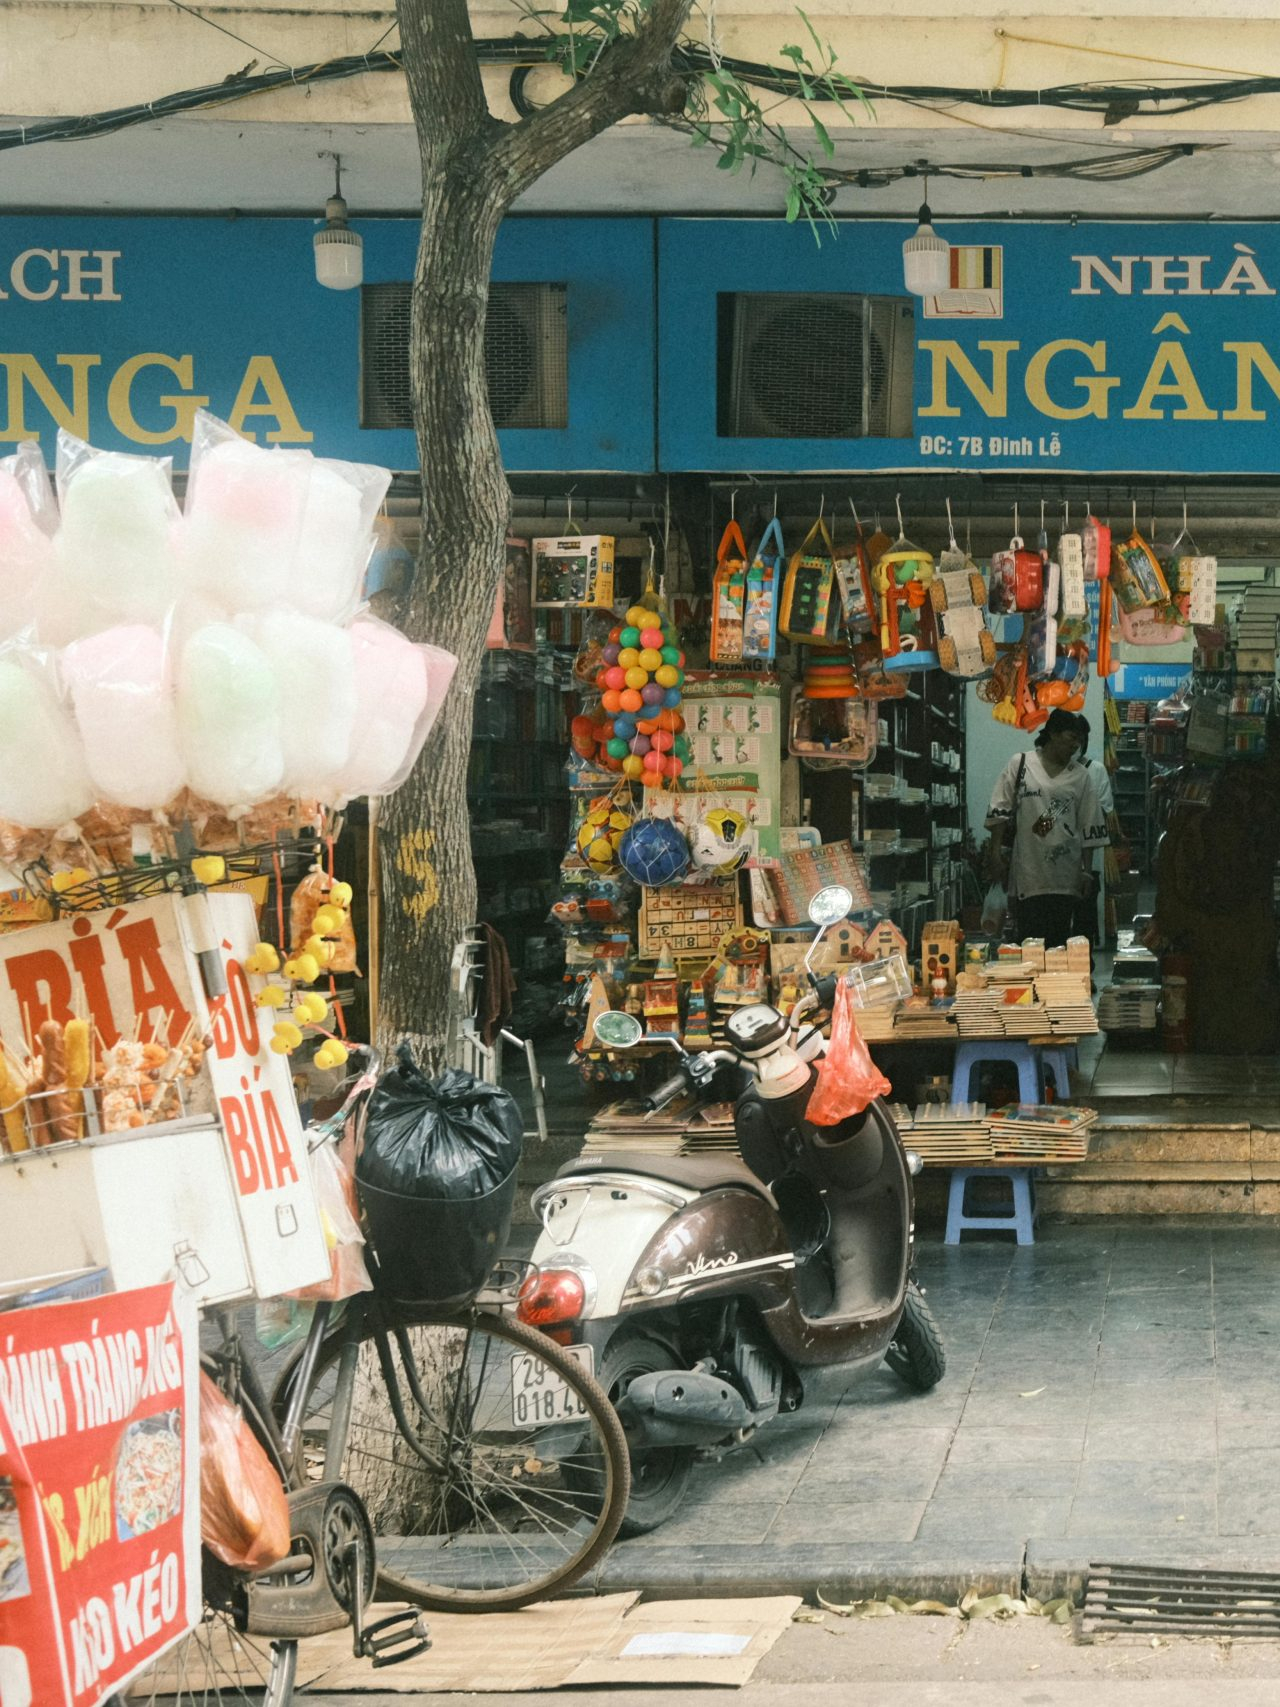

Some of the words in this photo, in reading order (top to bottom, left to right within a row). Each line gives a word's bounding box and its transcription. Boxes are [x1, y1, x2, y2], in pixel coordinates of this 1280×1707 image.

[1071, 242, 1277, 295] NHÀ
[0, 352, 314, 445] NGA
[919, 436, 953, 456] ĐC:
[958, 436, 983, 456] 7B
[988, 436, 1033, 457] Đinh
[1038, 431, 1062, 457] Lễ
